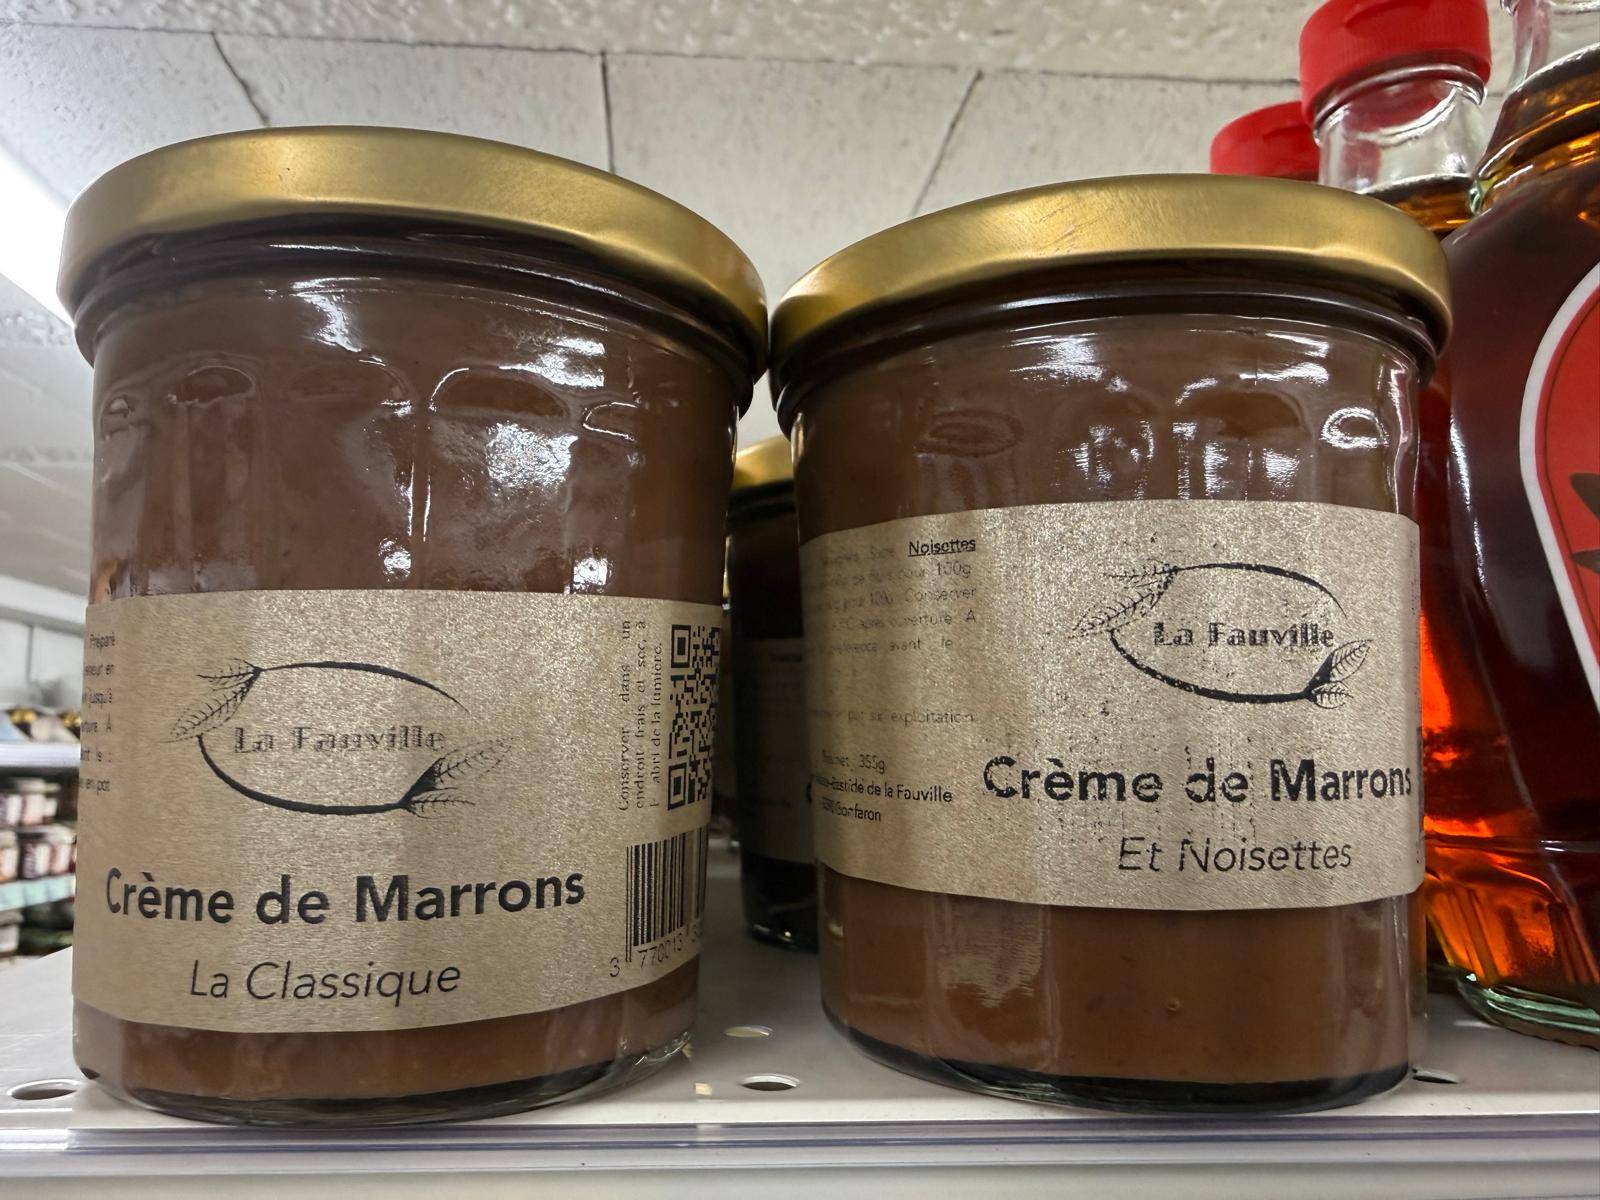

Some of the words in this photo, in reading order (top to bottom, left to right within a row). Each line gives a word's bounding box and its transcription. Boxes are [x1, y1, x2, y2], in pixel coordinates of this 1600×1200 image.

[908, 539, 977, 557] Noisettes
[622, 619, 632, 640] un
[1153, 622, 1194, 648] La
[1207, 620, 1336, 649] Fauville
[618, 664, 632, 704] dans
[637, 679, 647, 694] et
[635, 704, 647, 740] frais
[651, 710, 662, 726] la
[890, 708, 974, 728] exploitation
[235, 727, 275, 754] La
[293, 725, 446, 751] Fauville
[653, 728, 662, 747] de
[618, 726, 632, 812] Conserver
[635, 750, 646, 810] endroit
[983, 755, 1163, 802] Crème
[1185, 756, 1250, 803] de
[1270, 757, 1412, 802] Marrons
[866, 780, 882, 797] de
[884, 781, 894, 799] la
[896, 783, 953, 804] Fauville
[1118, 837, 1161, 872] Et
[1178, 836, 1352, 872] Noisettes
[106, 866, 235, 925] Crème
[255, 874, 330, 925] de
[356, 872, 585, 924] Marrons
[609, 956, 621, 978] 3
[190, 959, 230, 999] La
[246, 960, 462, 1008] Classique
